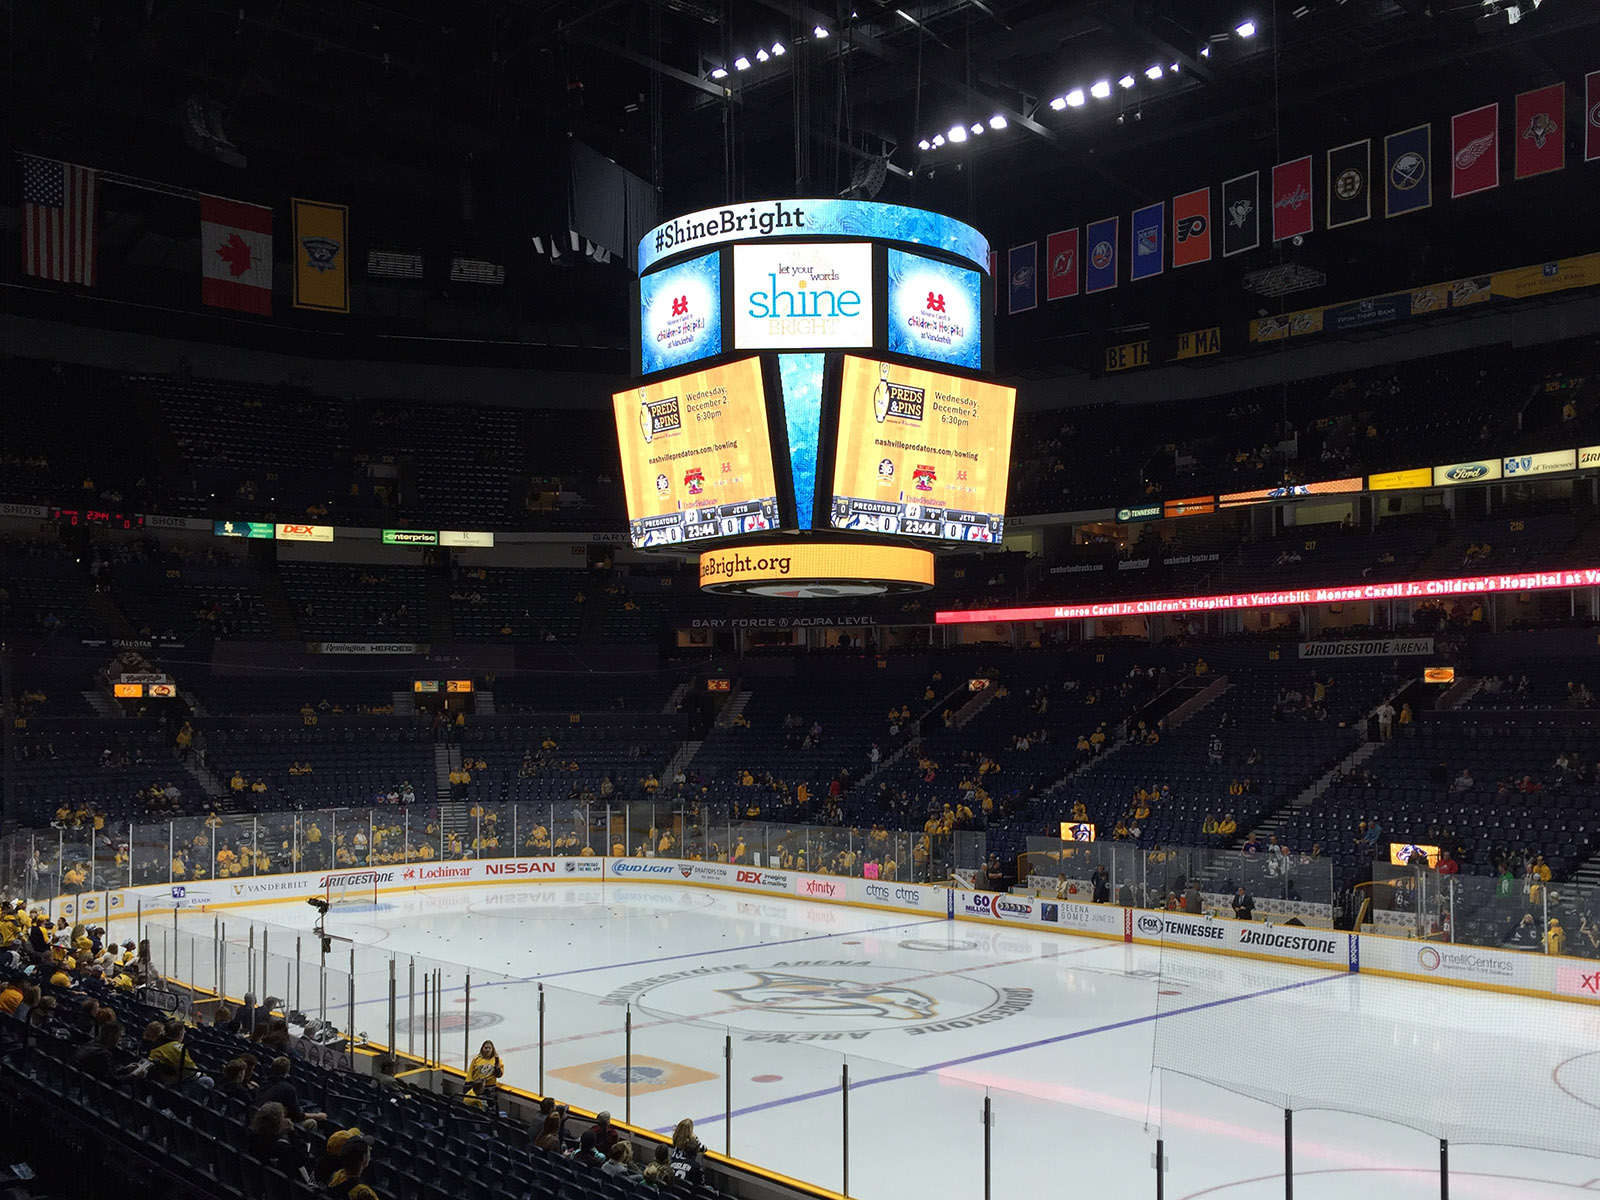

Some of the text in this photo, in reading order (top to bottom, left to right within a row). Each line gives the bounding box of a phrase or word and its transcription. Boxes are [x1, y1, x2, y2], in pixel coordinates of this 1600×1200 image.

[655, 202, 805, 253] #ShineBright
[778, 263, 814, 276] let your
[810, 269, 840, 280] words
[749, 273, 861, 318] shine
[1110, 346, 1126, 368] BE
[890, 387, 924, 403] PREDS
[651, 401, 678, 417] PREDS
[686, 399, 721, 412] December
[933, 401, 971, 415] December
[696, 410, 722, 423] 6:30pm
[941, 414, 969, 427] 6:30pm
[649, 440, 738, 464] nashvillepredators.com/bowling
[875, 438, 979, 461] nashvillepredators.com/bowling
[1453, 465, 1481, 479] Ford
[3, 505, 41, 516] SHOTS
[853, 502, 896, 514] PREDATORS
[152, 516, 186, 527] SHOTS
[644, 516, 678, 528] PREDATORS
[884, 518, 890, 531] 0
[959, 514, 976, 522] JETS
[283, 525, 314, 535] DEX
[687, 524, 715, 539] 23:44
[905, 520, 937, 535] 23:44
[951, 525, 956, 537] 0
[592, 533, 627, 541] GARY
[1055, 607, 1090, 618] Monroe
[1122, 602, 1135, 614] Jr.
[1137, 600, 1187, 612] Children's
[1190, 594, 1234, 609] Hospital
[1236, 597, 1248, 606] at
[1252, 590, 1311, 604] Vanderbilt
[1317, 588, 1362, 601] Monroe
[1406, 582, 1423, 596] Jr.
[1427, 577, 1496, 594] Children's
[1500, 573, 1562, 589] Hospital
[1566, 572, 1581, 584] at
[692, 616, 876, 627] GARY FORCE ACURA LEVEL
[325, 643, 412, 653] Remington HEROES
[1304, 641, 1429, 657] BRIDGESTONE ARENA
[419, 866, 473, 880] Lochinvar
[485, 862, 556, 875] NISSAN
[617, 863, 644, 873] BUD
[643, 864, 675, 874] LIGHT
[319, 872, 395, 889] BRIDGESTONE
[736, 870, 763, 884] DEX
[764, 873, 788, 881] imaging
[248, 880, 309, 892] VANDERBILT
[806, 880, 836, 897] xfinity
[866, 883, 890, 898] ctms
[895, 886, 920, 901] ctms
[191, 897, 212, 905] BANK
[973, 894, 990, 907] 60
[965, 904, 990, 914] MILLION
[1061, 903, 1089, 913] SELENA
[1061, 911, 1089, 923] GOMEZ
[1143, 918, 1225, 940] FOX TENNESSEE
[1240, 929, 1337, 954] BRIDGESTONE
[772, 959, 872, 967] ARENA
[1441, 952, 1513, 971] IntelliCentrics
